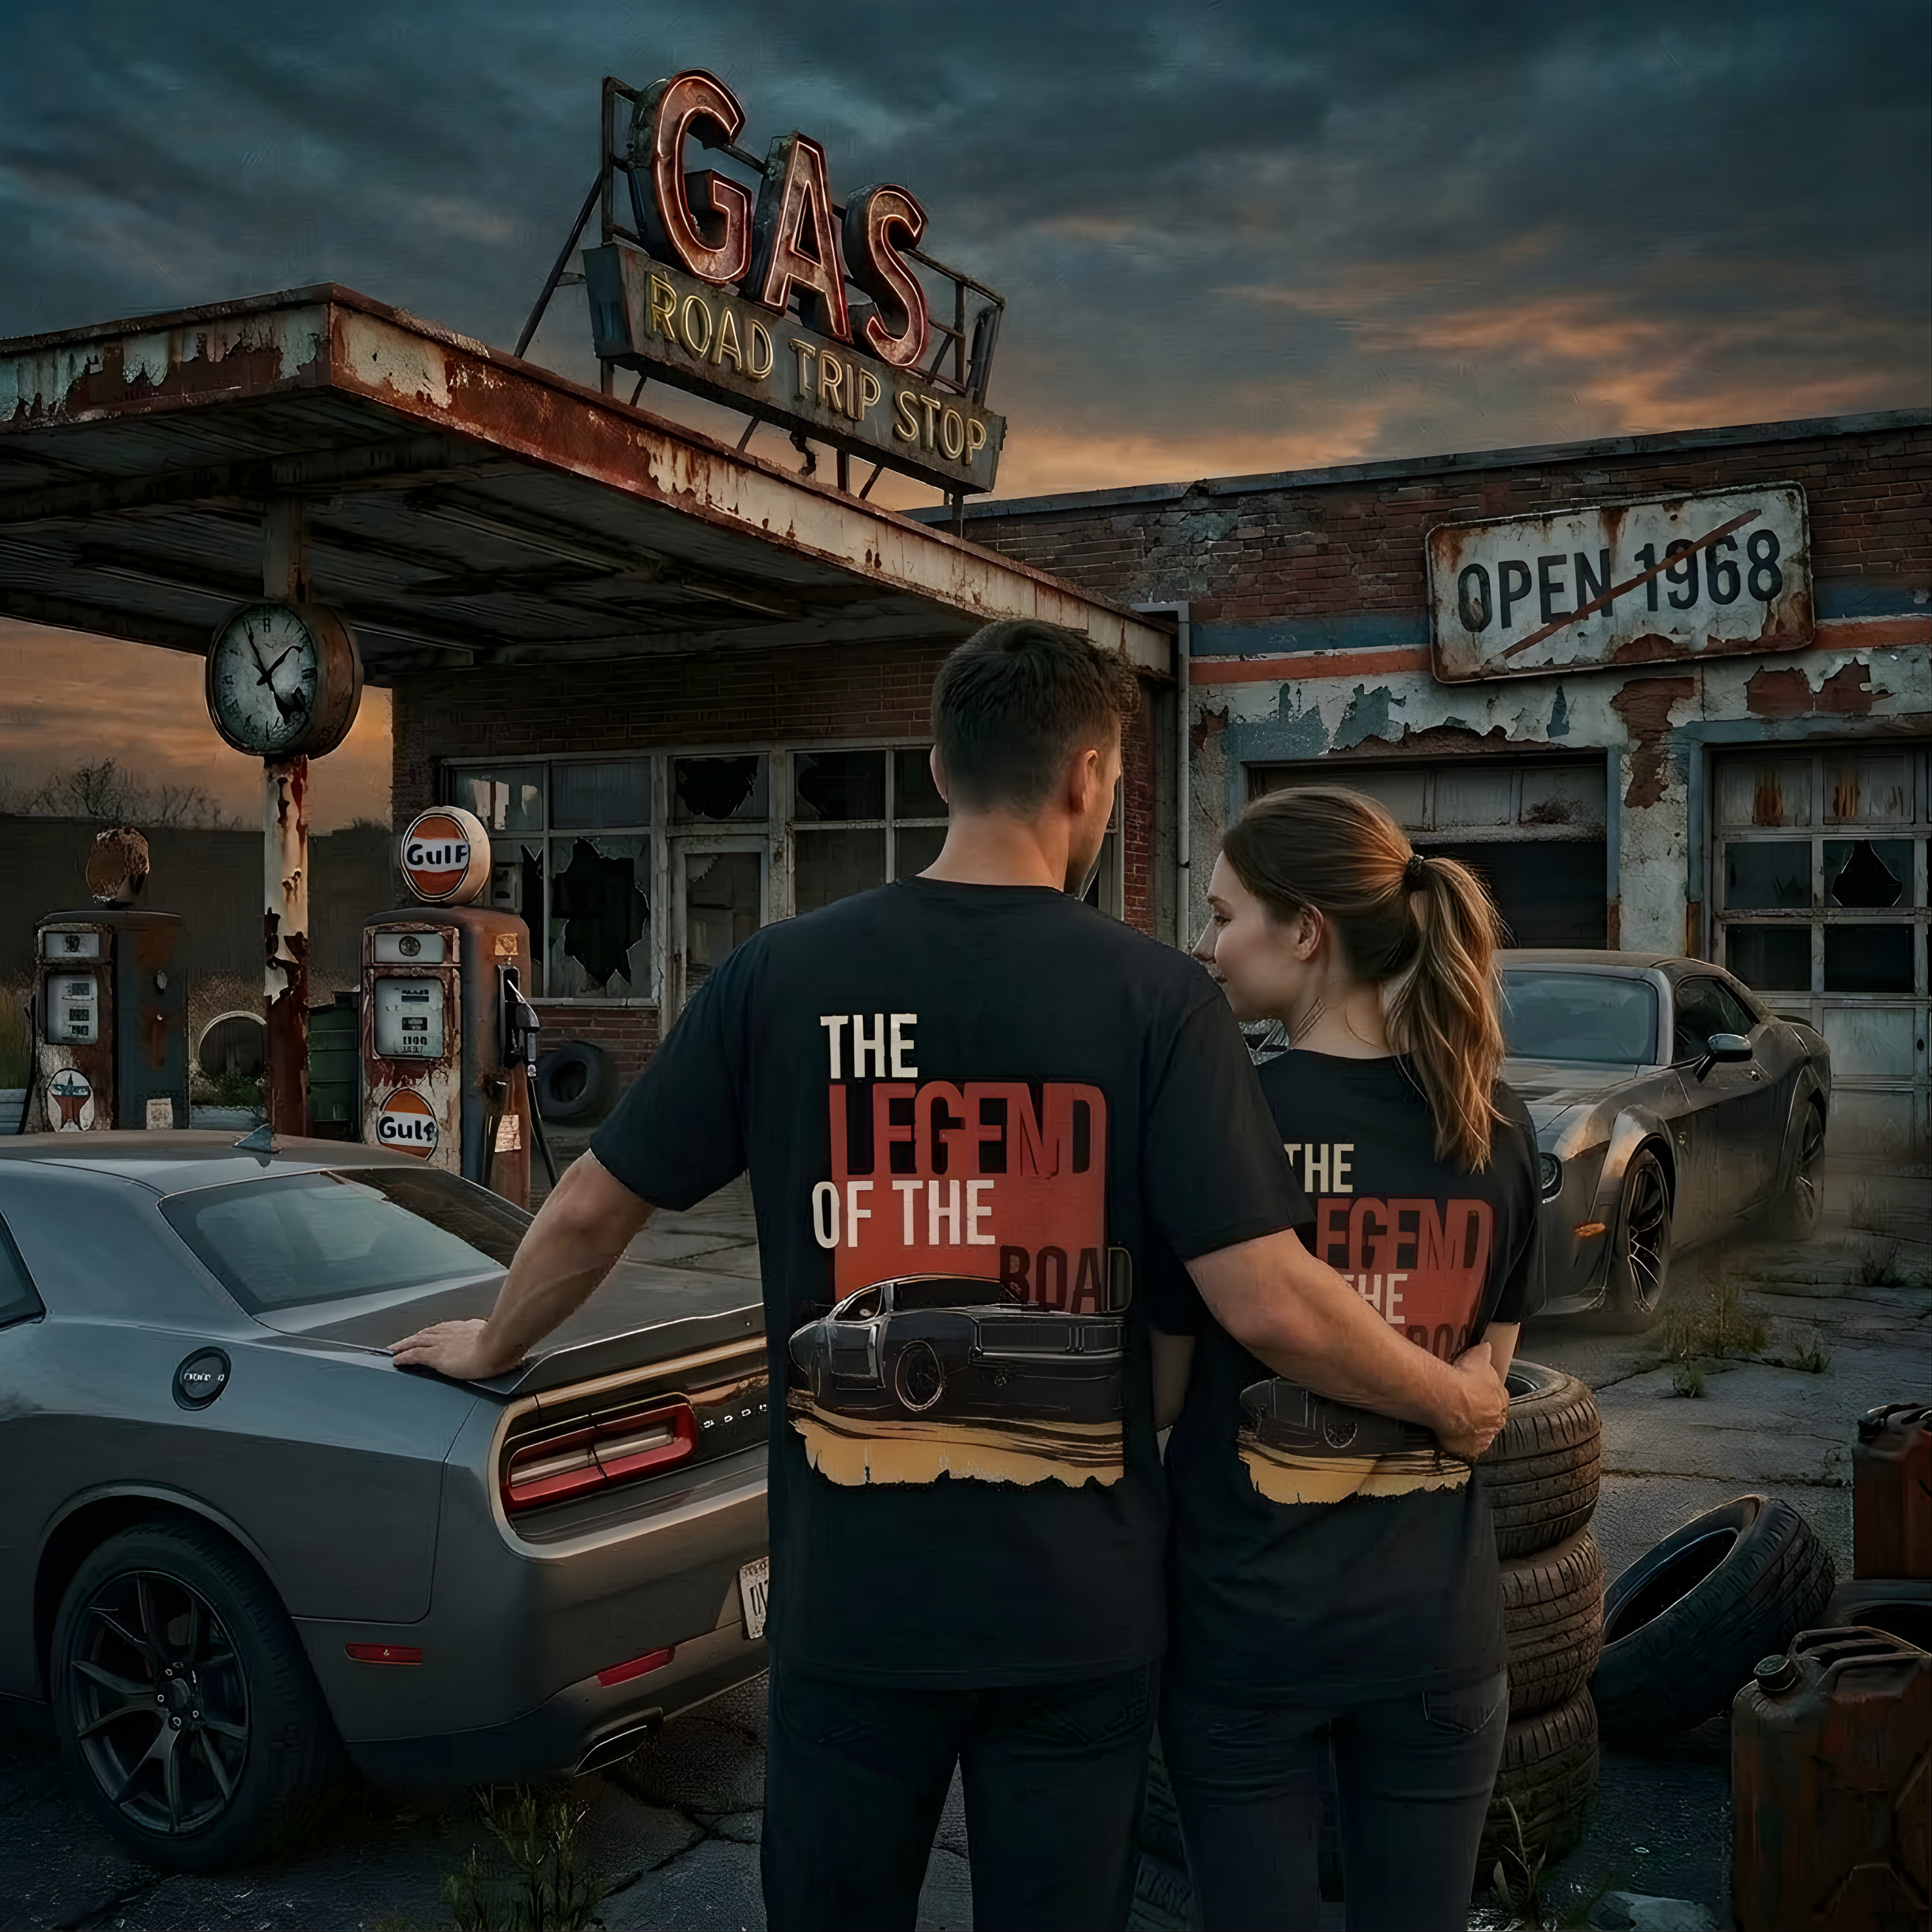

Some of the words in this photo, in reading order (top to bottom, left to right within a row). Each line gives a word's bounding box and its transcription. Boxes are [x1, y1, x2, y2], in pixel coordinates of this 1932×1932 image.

[649, 68, 928, 368] GAS
[650, 273, 773, 381] ROAD
[789, 338, 881, 422] TRIP
[895, 390, 986, 466] STOP
[1457, 549, 1613, 632] OPEN
[1634, 529, 1783, 612] 1968
[820, 1014, 918, 1079] THE
[829, 1081, 1106, 1176] LEGEND
[812, 1180, 873, 1249] OF
[893, 1180, 996, 1247] THE
[1316, 1197, 1493, 1271] EGEND
[999, 1245, 1132, 1314] ROAD
[1341, 1273, 1408, 1323] HE
